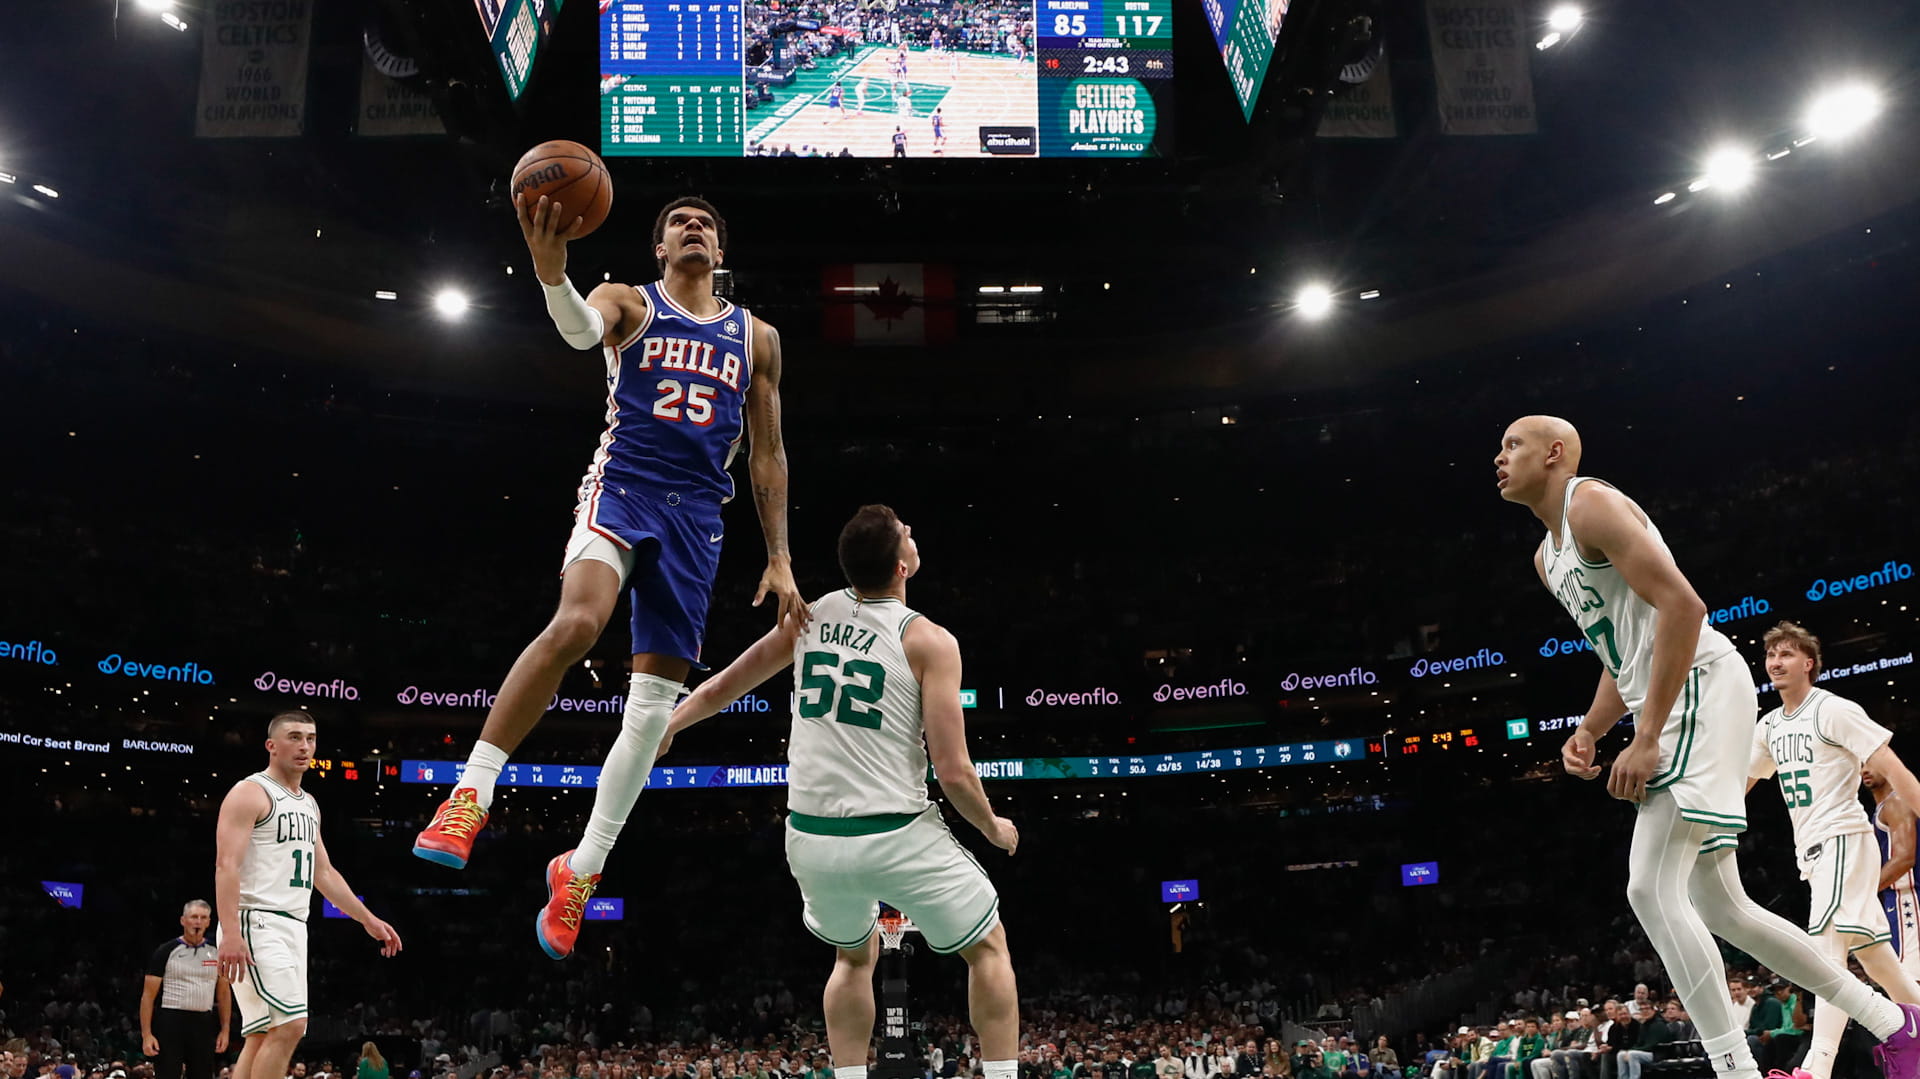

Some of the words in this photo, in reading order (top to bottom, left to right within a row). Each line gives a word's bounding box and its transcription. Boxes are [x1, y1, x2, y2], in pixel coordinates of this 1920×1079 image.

[1055, 14, 1086, 35] 85
[1116, 16, 1162, 35] 117
[217, 25, 298, 46] CELTICS
[1045, 58, 1060, 69] 16
[1083, 56, 1129, 73] 2:43
[1145, 59, 1164, 70] 4th
[237, 67, 272, 82] 1966
[225, 86, 281, 100] WORLD
[1076, 85, 1136, 109] CELTICS
[204, 104, 299, 121] CHAMPIONS
[1070, 110, 1144, 134] PLAYOFFS
[986, 137, 1005, 146] abu
[1004, 137, 1031, 146] dhabi
[639, 337, 742, 390] PHILA
[652, 378, 717, 424] 25
[1829, 560, 1912, 597] evenflo
[1708, 596, 1770, 626] venflo
[820, 623, 878, 655] GARZA
[1585, 616, 1622, 679] 7
[1430, 649, 1504, 674] evenflo
[1831, 667, 1851, 678] Car
[1852, 661, 1878, 674] Seat
[1880, 653, 1912, 668] Brand
[124, 662, 212, 684] evenflo
[1301, 667, 1375, 689] evenflo
[278, 679, 358, 700] evenflo
[799, 651, 886, 730] 52
[1046, 688, 1118, 705] evenflo
[1173, 679, 1245, 700] evenflo
[560, 695, 625, 712] evenfl
[1508, 722, 1527, 736] TD
[1539, 717, 1564, 732] 3:27
[22, 734, 43, 747] Car
[44, 737, 72, 750] Seat
[74, 740, 110, 753] Brand
[1432, 731, 1453, 744] 2:43
[1464, 735, 1479, 747] 85
[122, 739, 194, 754] BARLOW.RON
[1369, 743, 1382, 753] 16
[1770, 733, 1813, 765] CELTICS
[1196, 758, 1221, 769] 14/38
[1235, 757, 1242, 766] 8
[1258, 755, 1265, 765] 7
[1279, 753, 1292, 763] 29
[1303, 751, 1315, 761] 40
[308, 757, 332, 771] 2:43
[385, 765, 398, 776] 16
[975, 761, 1024, 778] BOSTON
[1092, 766, 1098, 775] 3
[1111, 765, 1119, 774] 4
[1129, 765, 1147, 774] 50.6
[1156, 761, 1182, 772] 43/85
[344, 766, 359, 781] 85
[510, 773, 517, 783] 3
[532, 774, 543, 783] 14
[560, 774, 583, 785] 4/22
[666, 776, 673, 786] 3
[688, 775, 696, 785] 4
[1778, 770, 1812, 809] 55
[276, 811, 319, 845] CELTIC
[289, 849, 312, 890] 11
[885, 1052, 906, 1060] Google
